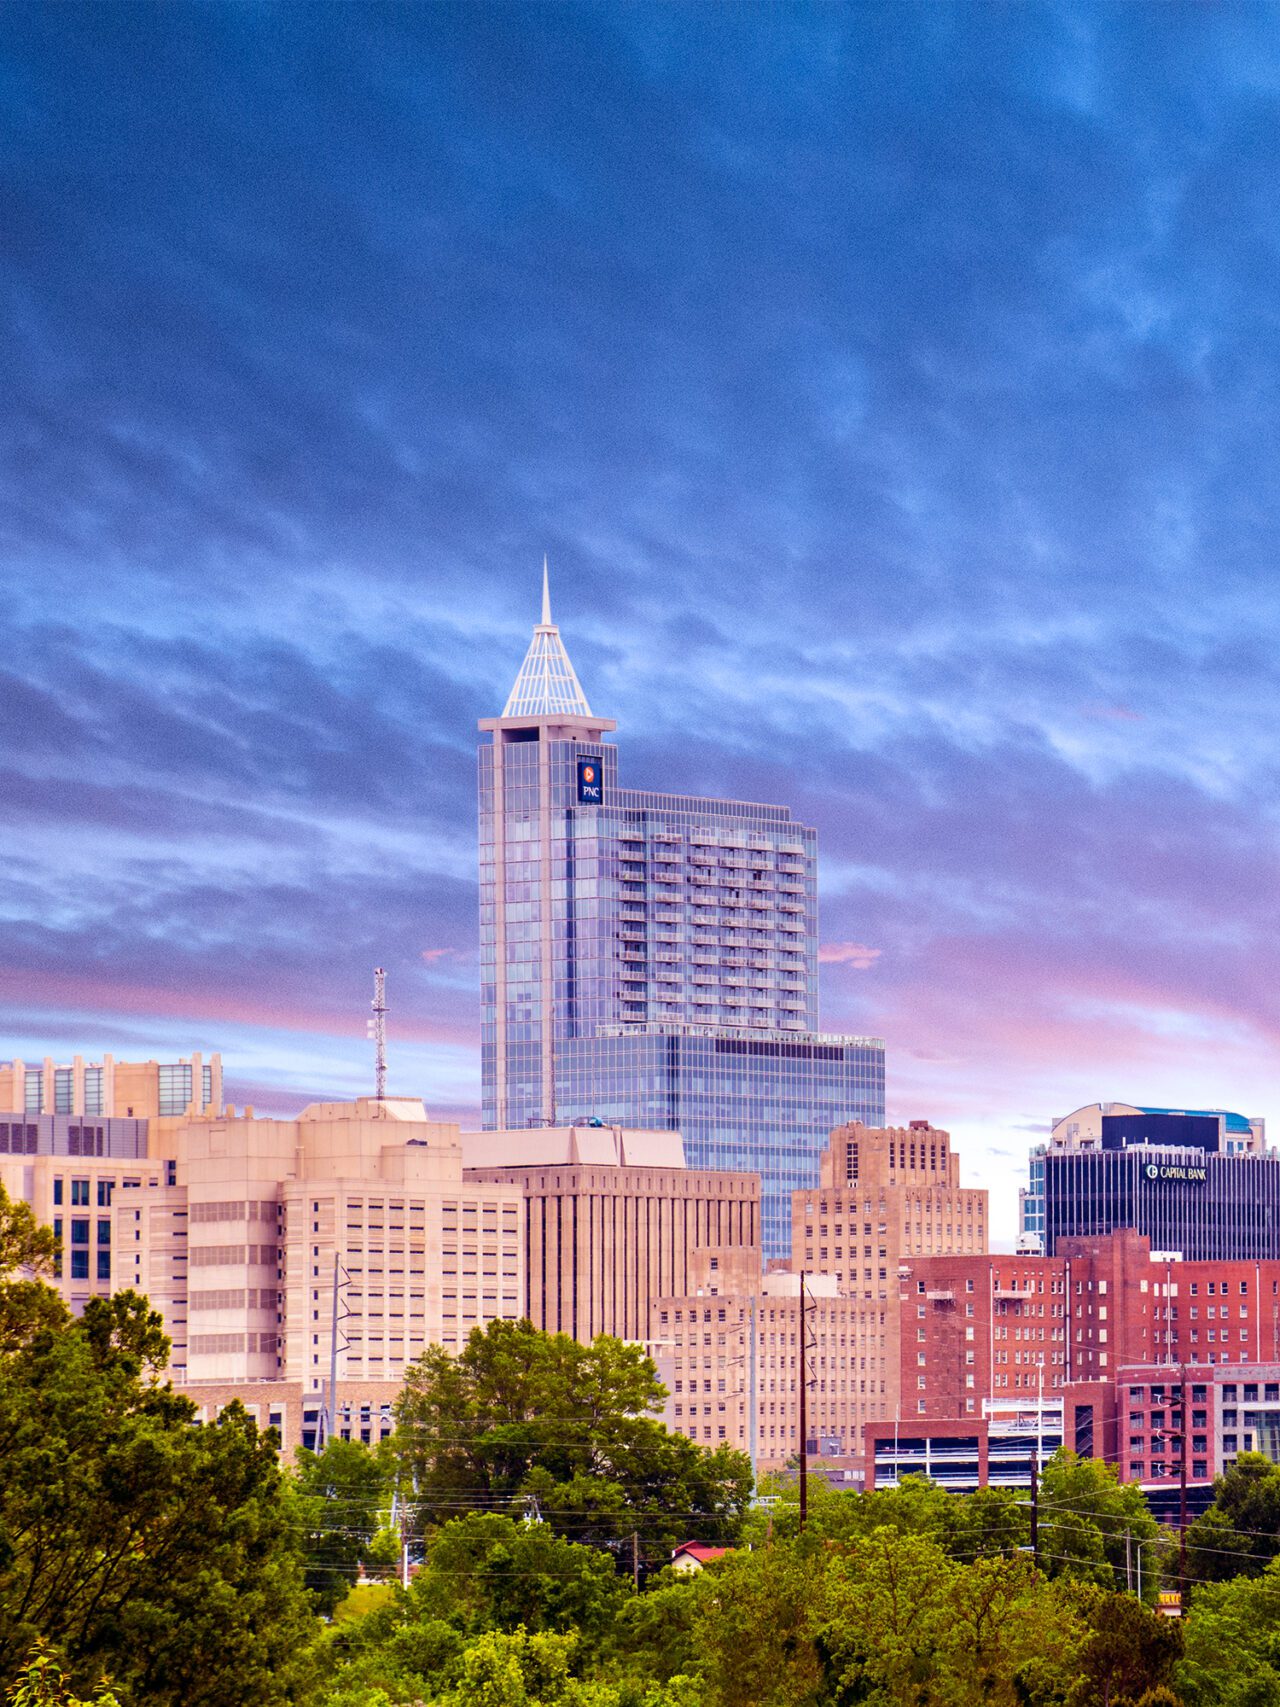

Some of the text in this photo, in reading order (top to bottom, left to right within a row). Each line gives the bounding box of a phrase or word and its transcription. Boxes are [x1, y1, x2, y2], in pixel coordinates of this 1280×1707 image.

[583, 786, 599, 797] PNC
[1160, 1166, 1206, 1180] CAPITAL BANK
